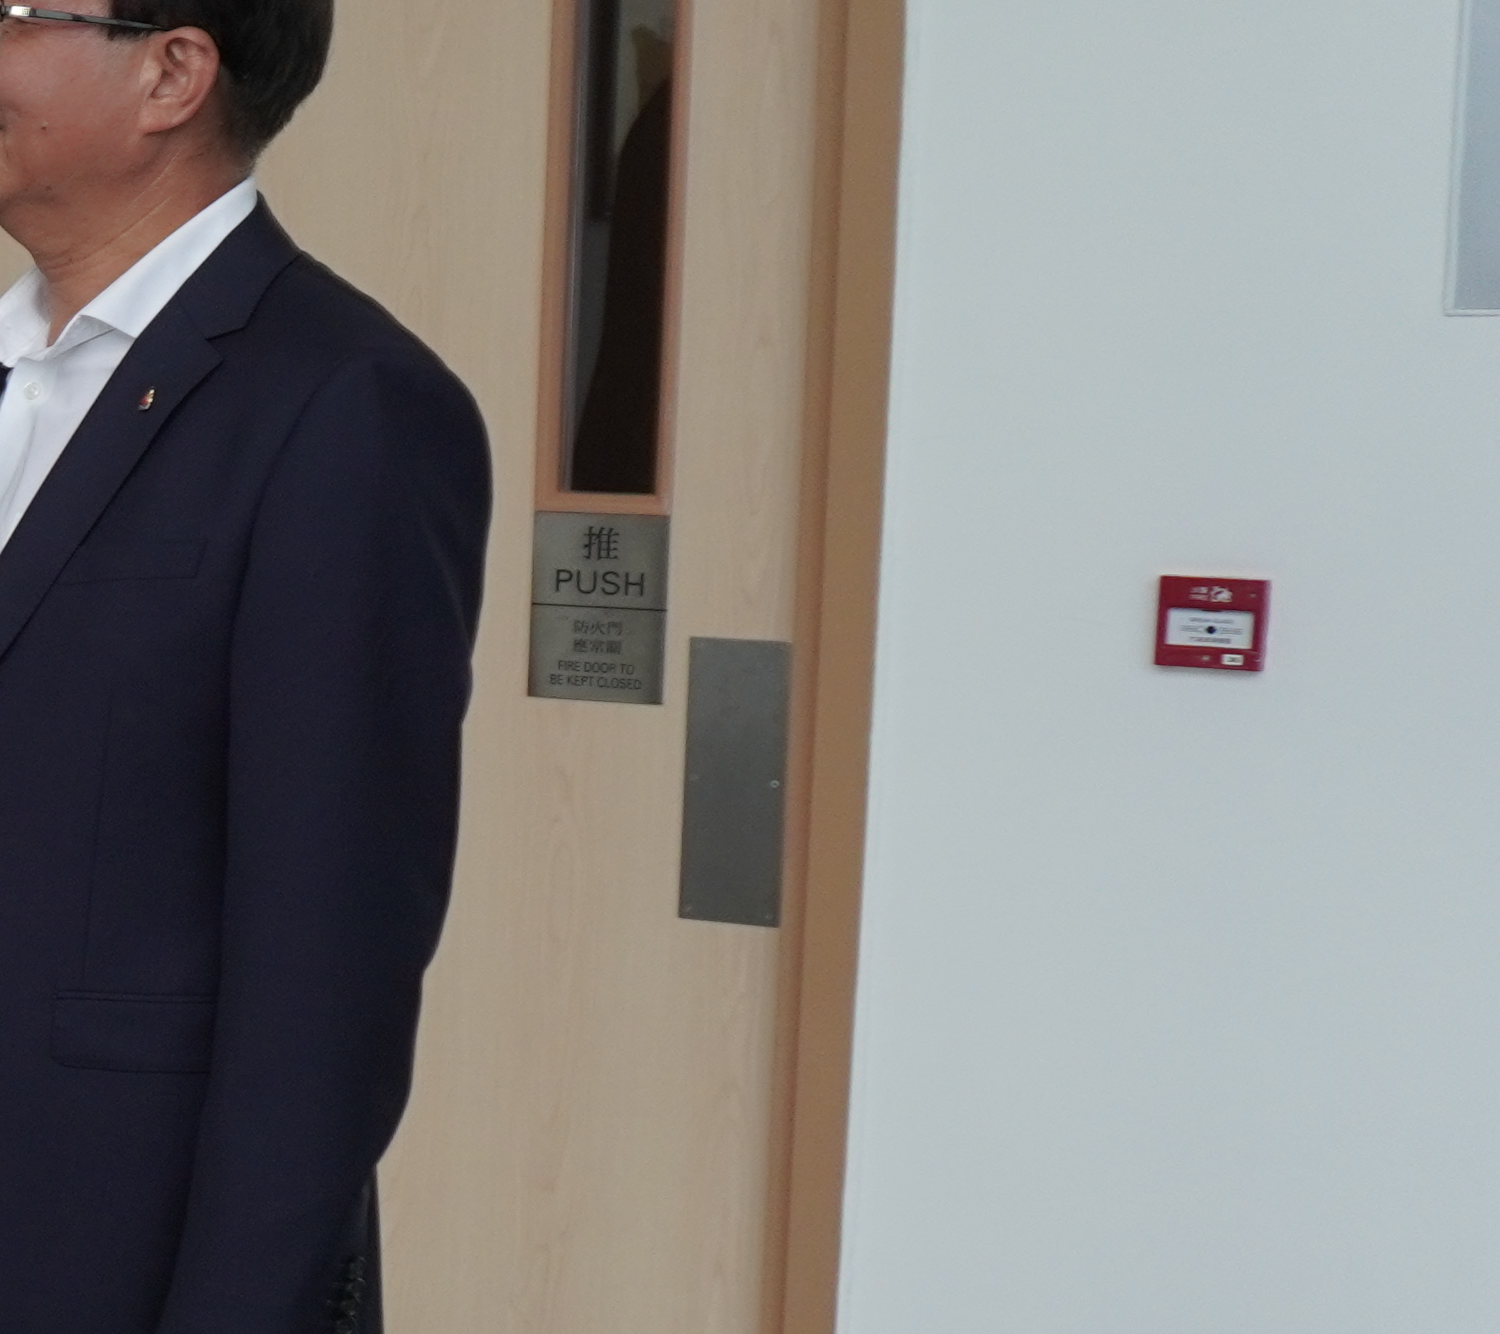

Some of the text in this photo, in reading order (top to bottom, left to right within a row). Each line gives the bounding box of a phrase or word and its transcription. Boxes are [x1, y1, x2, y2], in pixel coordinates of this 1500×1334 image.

[583, 526, 620, 560] 推
[555, 569, 645, 597] PUSH
[558, 660, 635, 675] FIRE DOOR TO
[549, 673, 642, 690] BE KEPT CLOSED
